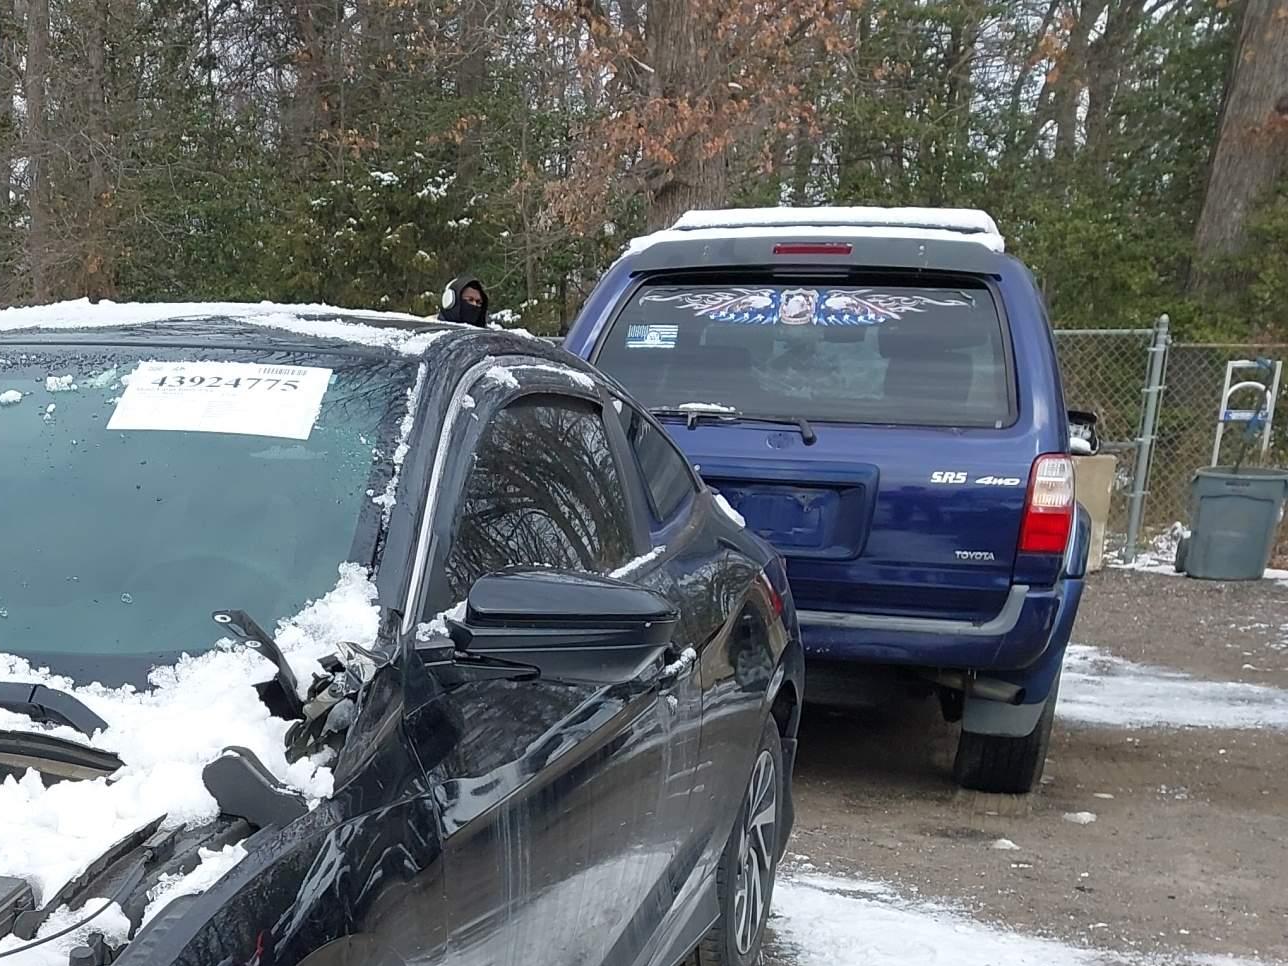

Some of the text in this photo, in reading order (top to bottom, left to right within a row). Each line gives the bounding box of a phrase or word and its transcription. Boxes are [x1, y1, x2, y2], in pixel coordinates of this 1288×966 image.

[151, 375, 301, 392] 43924775
[930, 471, 1021, 486] SR5 4WD
[954, 550, 995, 561] TOYOTA
